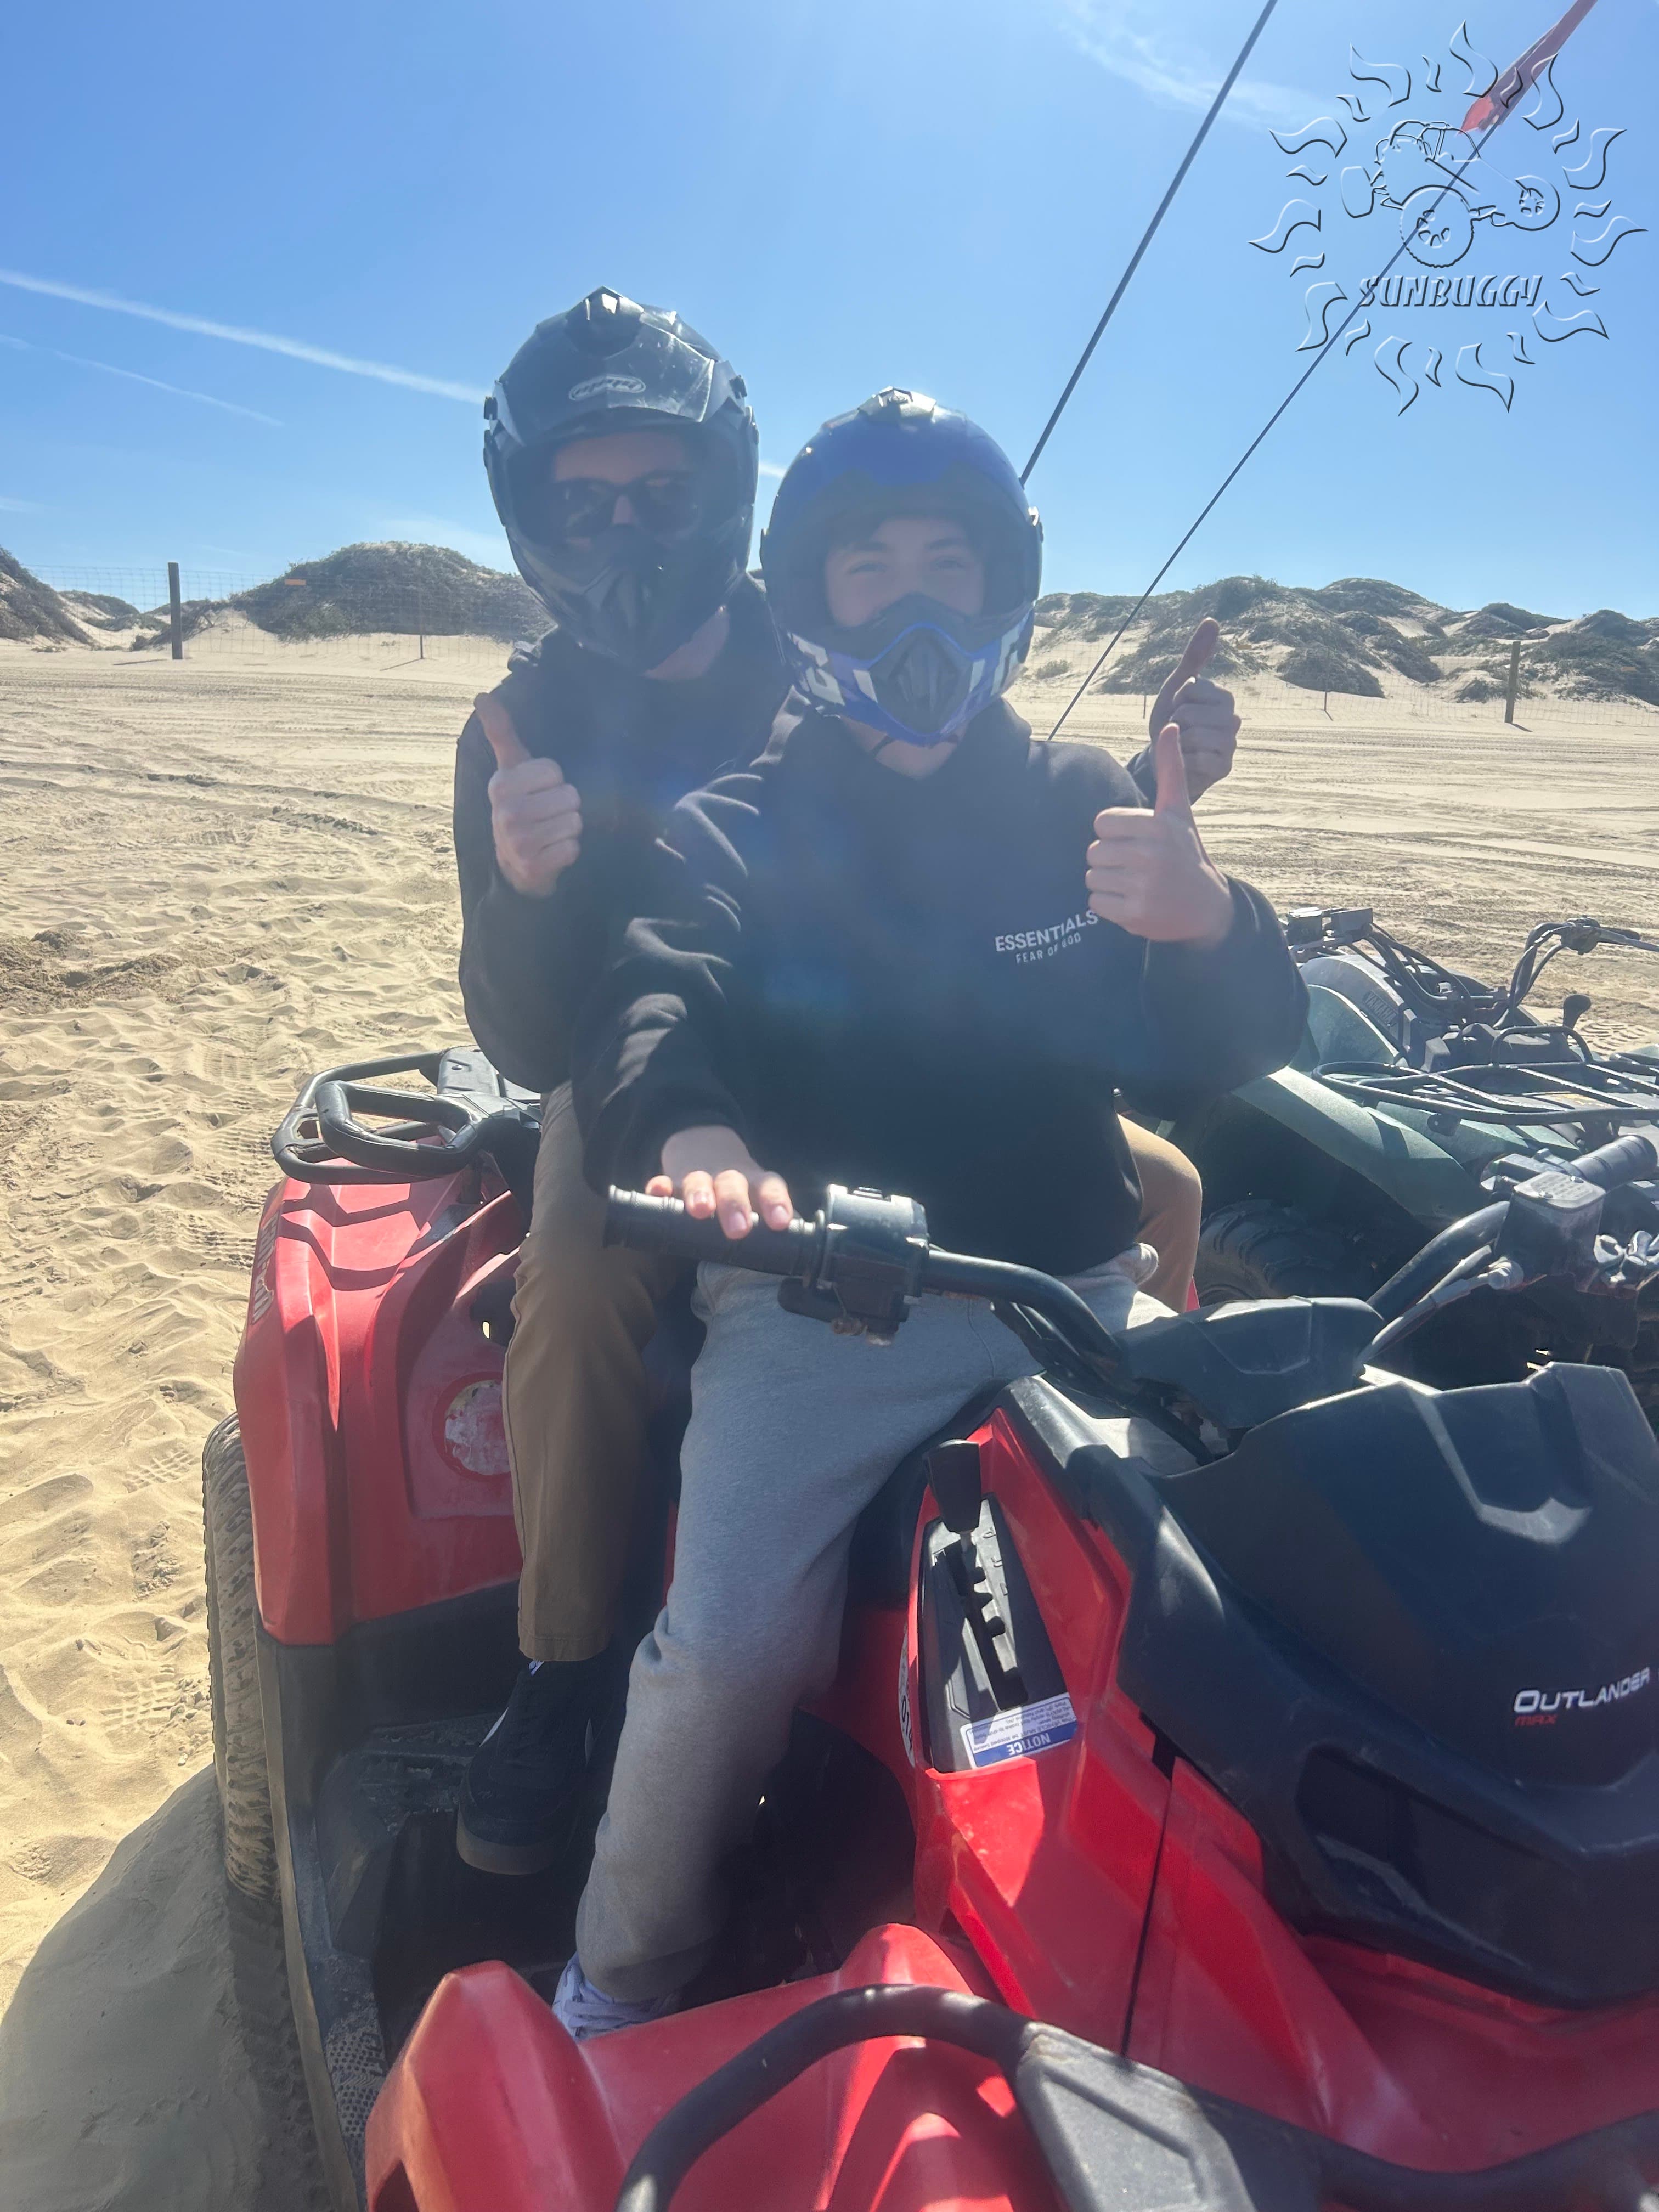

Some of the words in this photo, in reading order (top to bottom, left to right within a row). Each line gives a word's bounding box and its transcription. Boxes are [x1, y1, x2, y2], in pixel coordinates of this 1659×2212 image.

[995, 909, 1098, 952] ESSENTIALS
[1016, 950, 1043, 964] FEAR
[1048, 943, 1058, 956] OF
[1062, 932, 1081, 948] GOD
[1007, 1733, 1051, 1756] NOTICE
